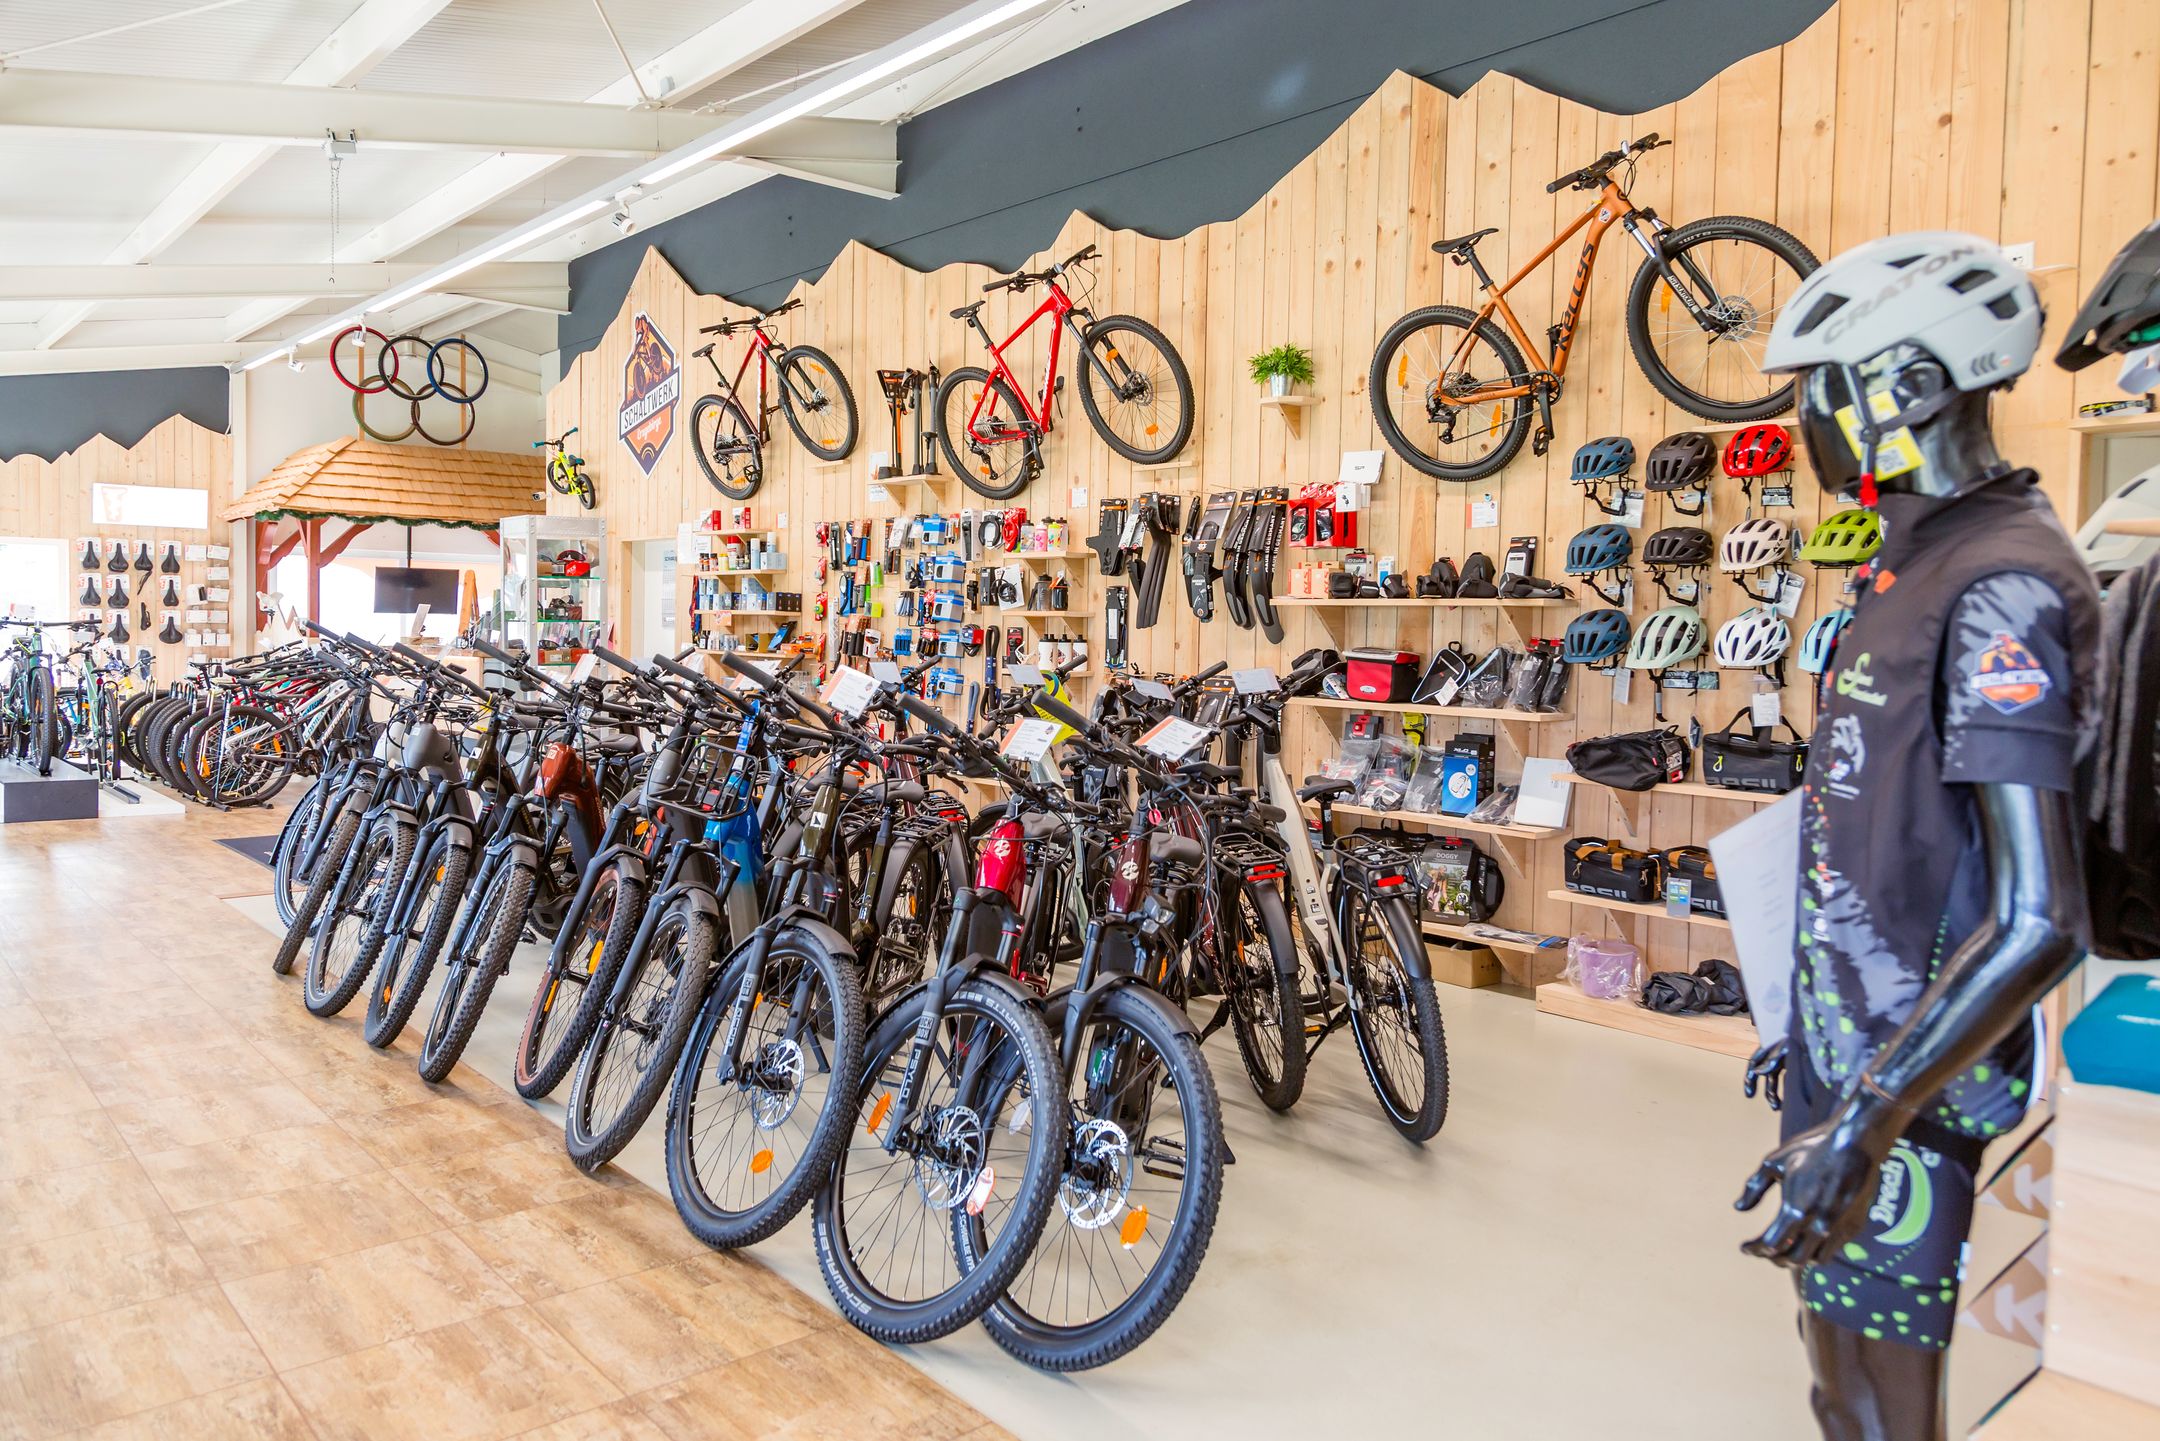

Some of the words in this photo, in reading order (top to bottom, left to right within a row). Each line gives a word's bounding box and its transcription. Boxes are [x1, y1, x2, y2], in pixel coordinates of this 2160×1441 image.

[1823, 246, 1974, 345] CRATON
[624, 380, 673, 428] SCHALTWERK
[1687, 621, 1698, 642] KLS
[1436, 852, 1459, 860] DOGGY
[985, 998, 1020, 1034] WATTS
[902, 1049, 921, 1098] PSYLO
[1019, 1036, 1039, 1099] JOHNNY
[818, 1223, 872, 1315] SCHWALBE
